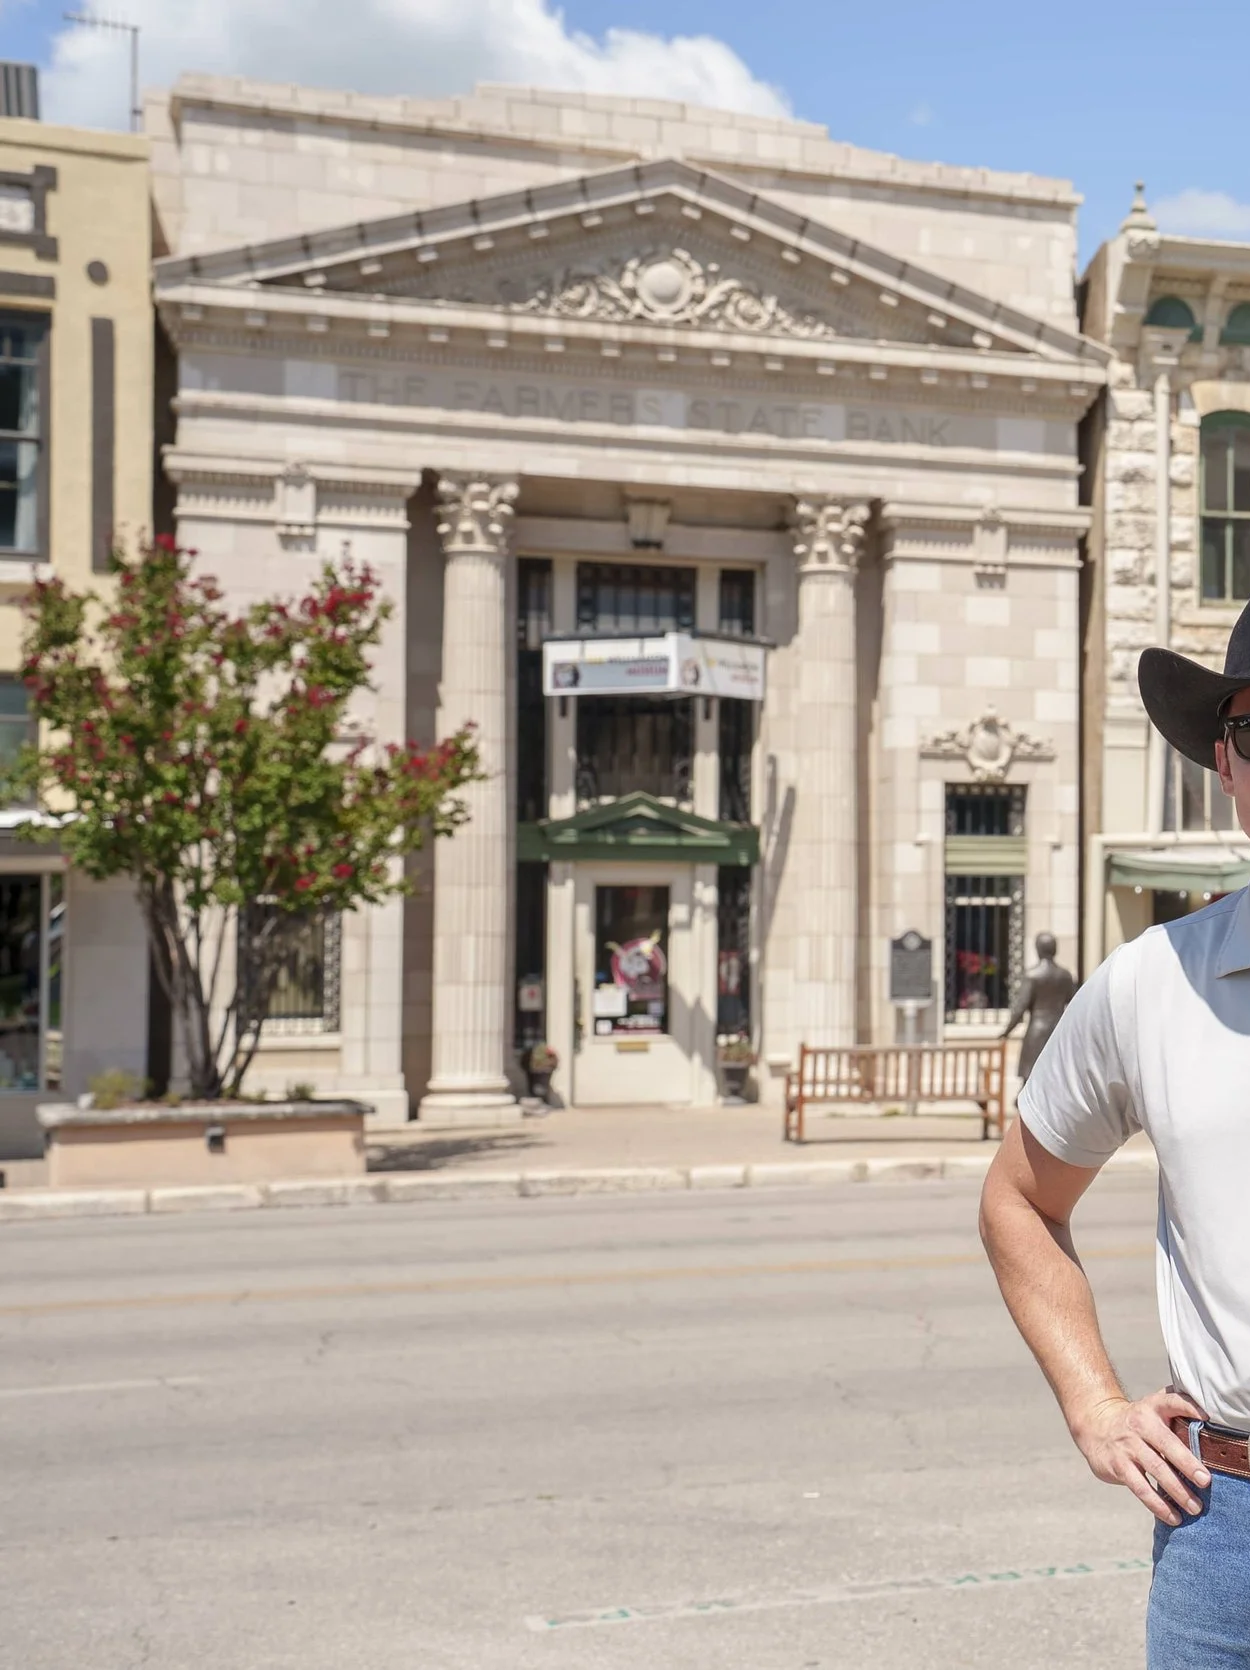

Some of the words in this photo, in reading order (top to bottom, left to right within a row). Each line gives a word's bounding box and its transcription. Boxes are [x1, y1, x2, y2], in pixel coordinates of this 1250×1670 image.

[339, 370, 428, 405] THE
[453, 379, 663, 425] FARMERS
[688, 398, 827, 438] STATE
[845, 410, 952, 446] BANK
